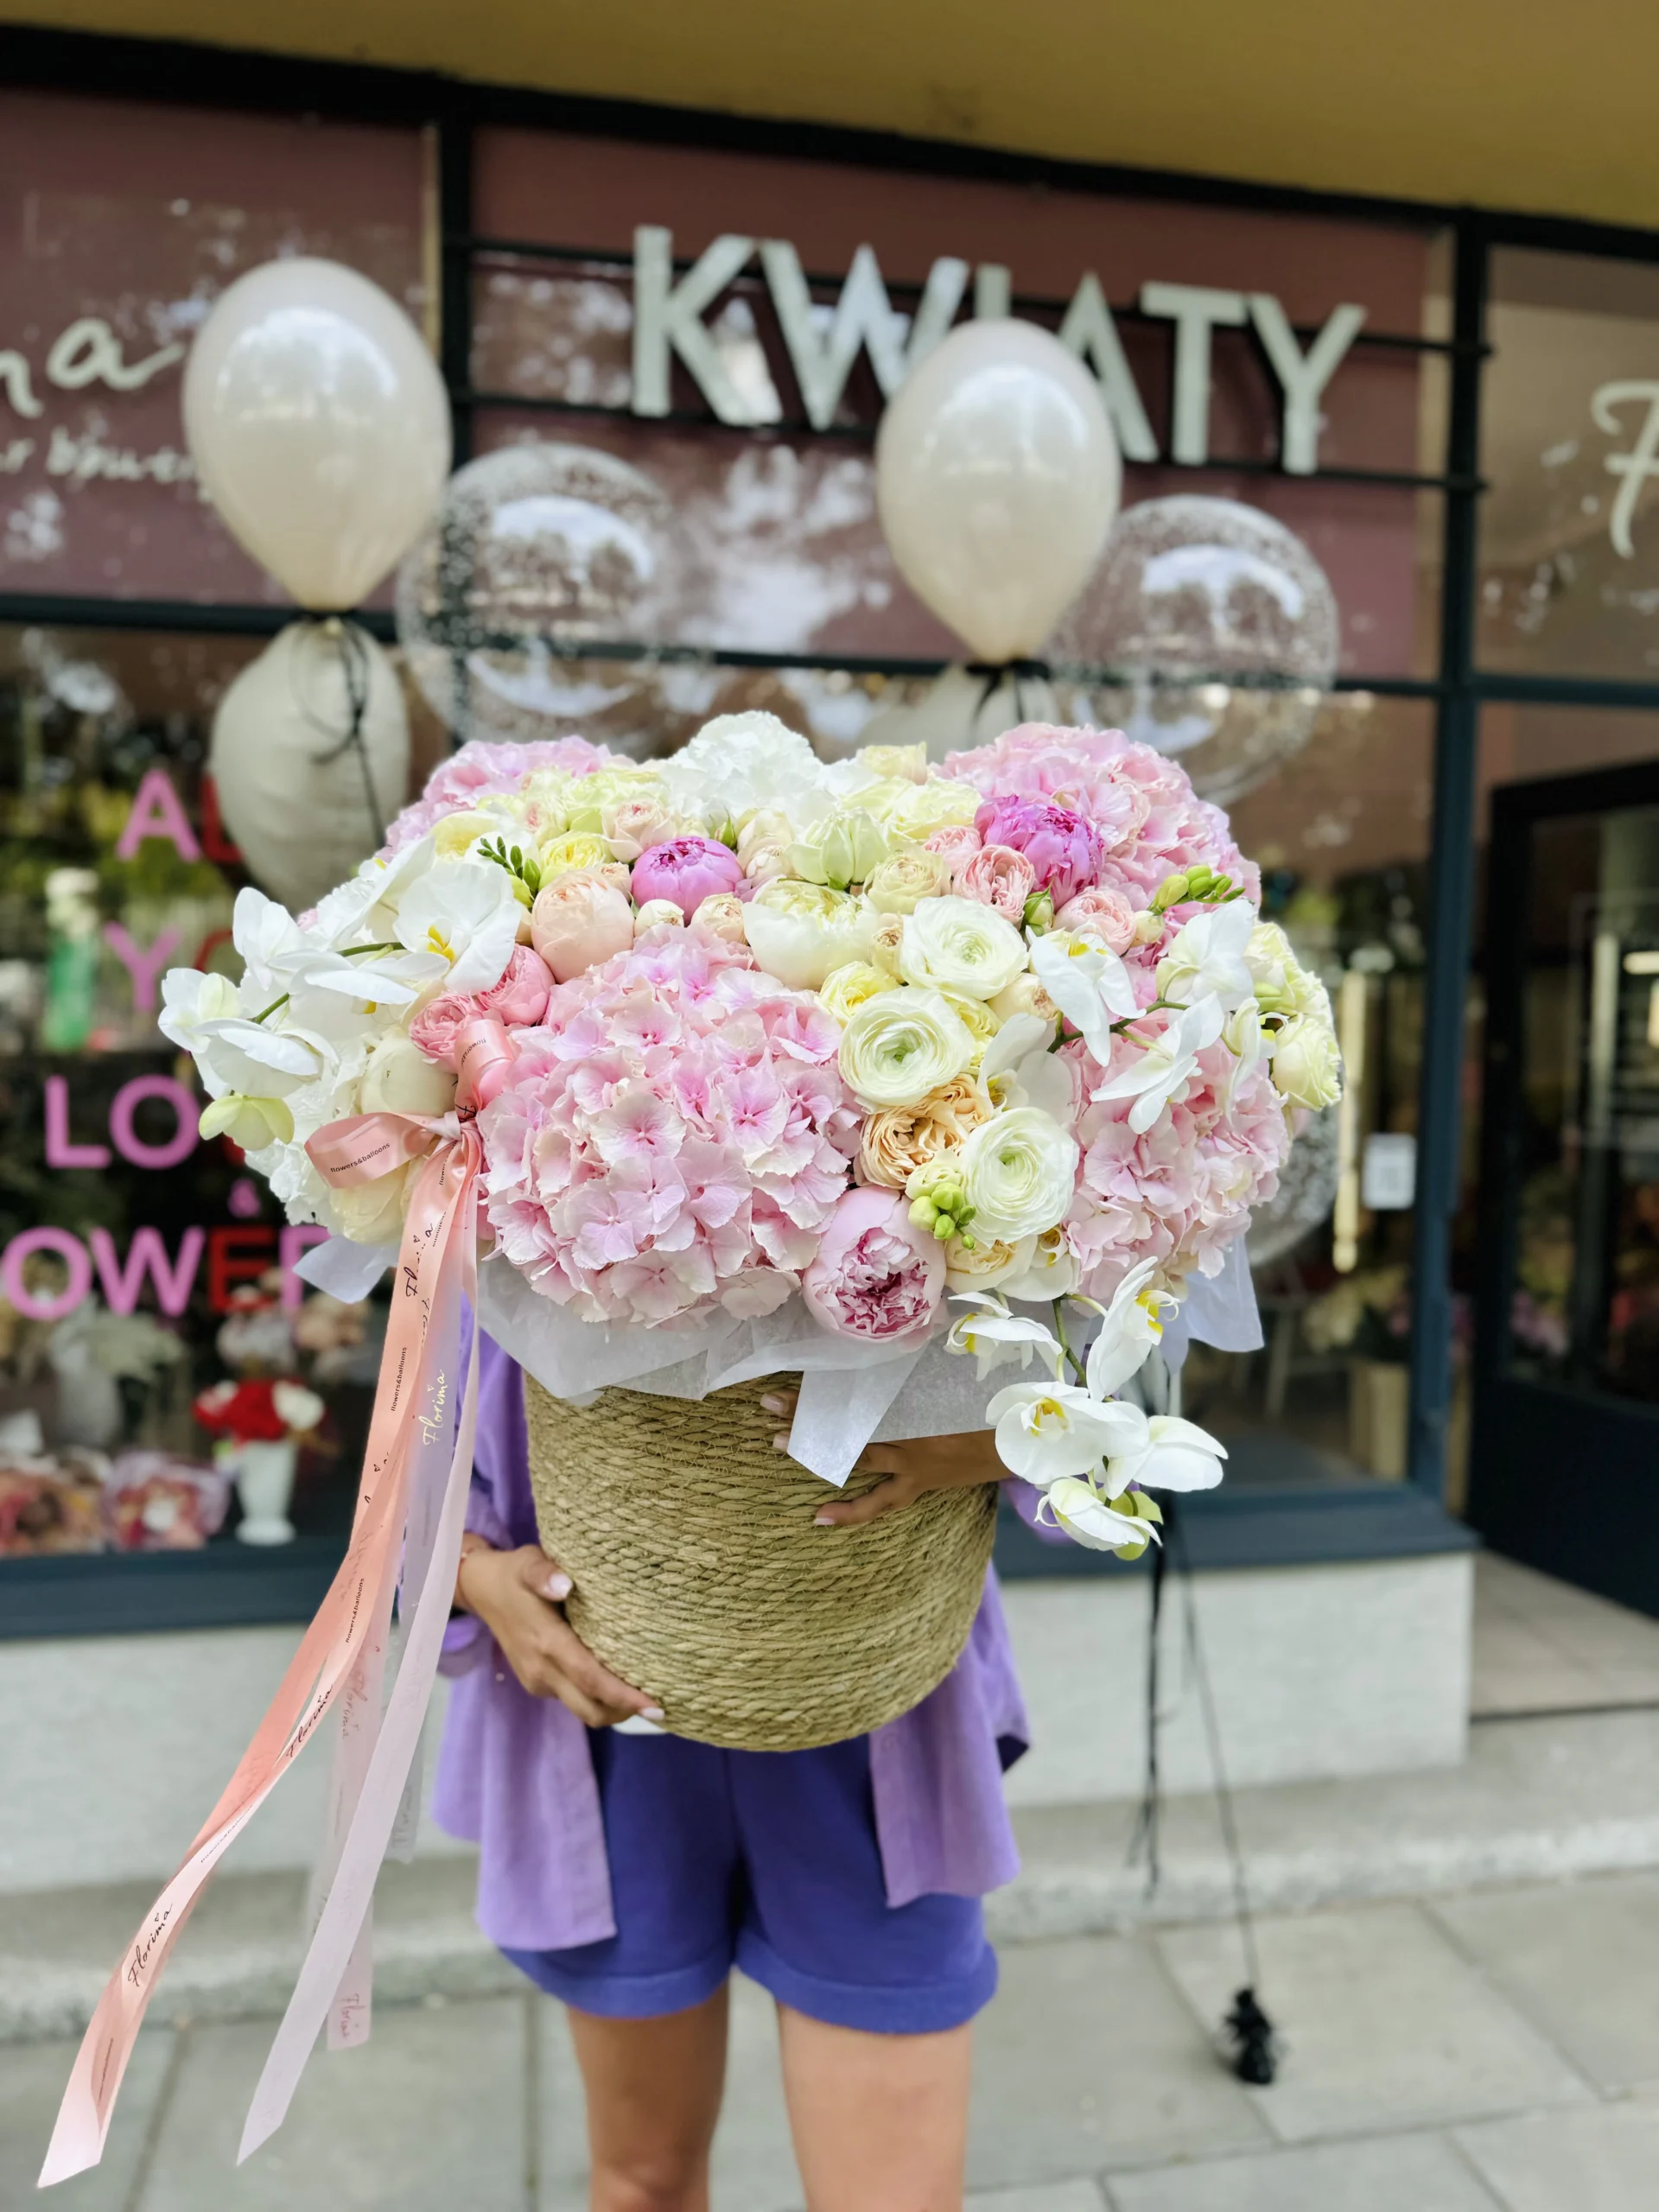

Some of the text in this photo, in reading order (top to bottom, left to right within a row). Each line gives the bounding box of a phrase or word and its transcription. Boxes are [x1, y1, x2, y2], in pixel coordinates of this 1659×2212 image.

[632, 224, 1368, 475] KWATY
[45, 1073, 245, 1170] LO
[329, 1141, 391, 1174] flowers&balloons
[390, 1346, 408, 1412] flowers&balloons
[418, 1369, 448, 1446] Florima
[127, 1903, 174, 1987] Florima
